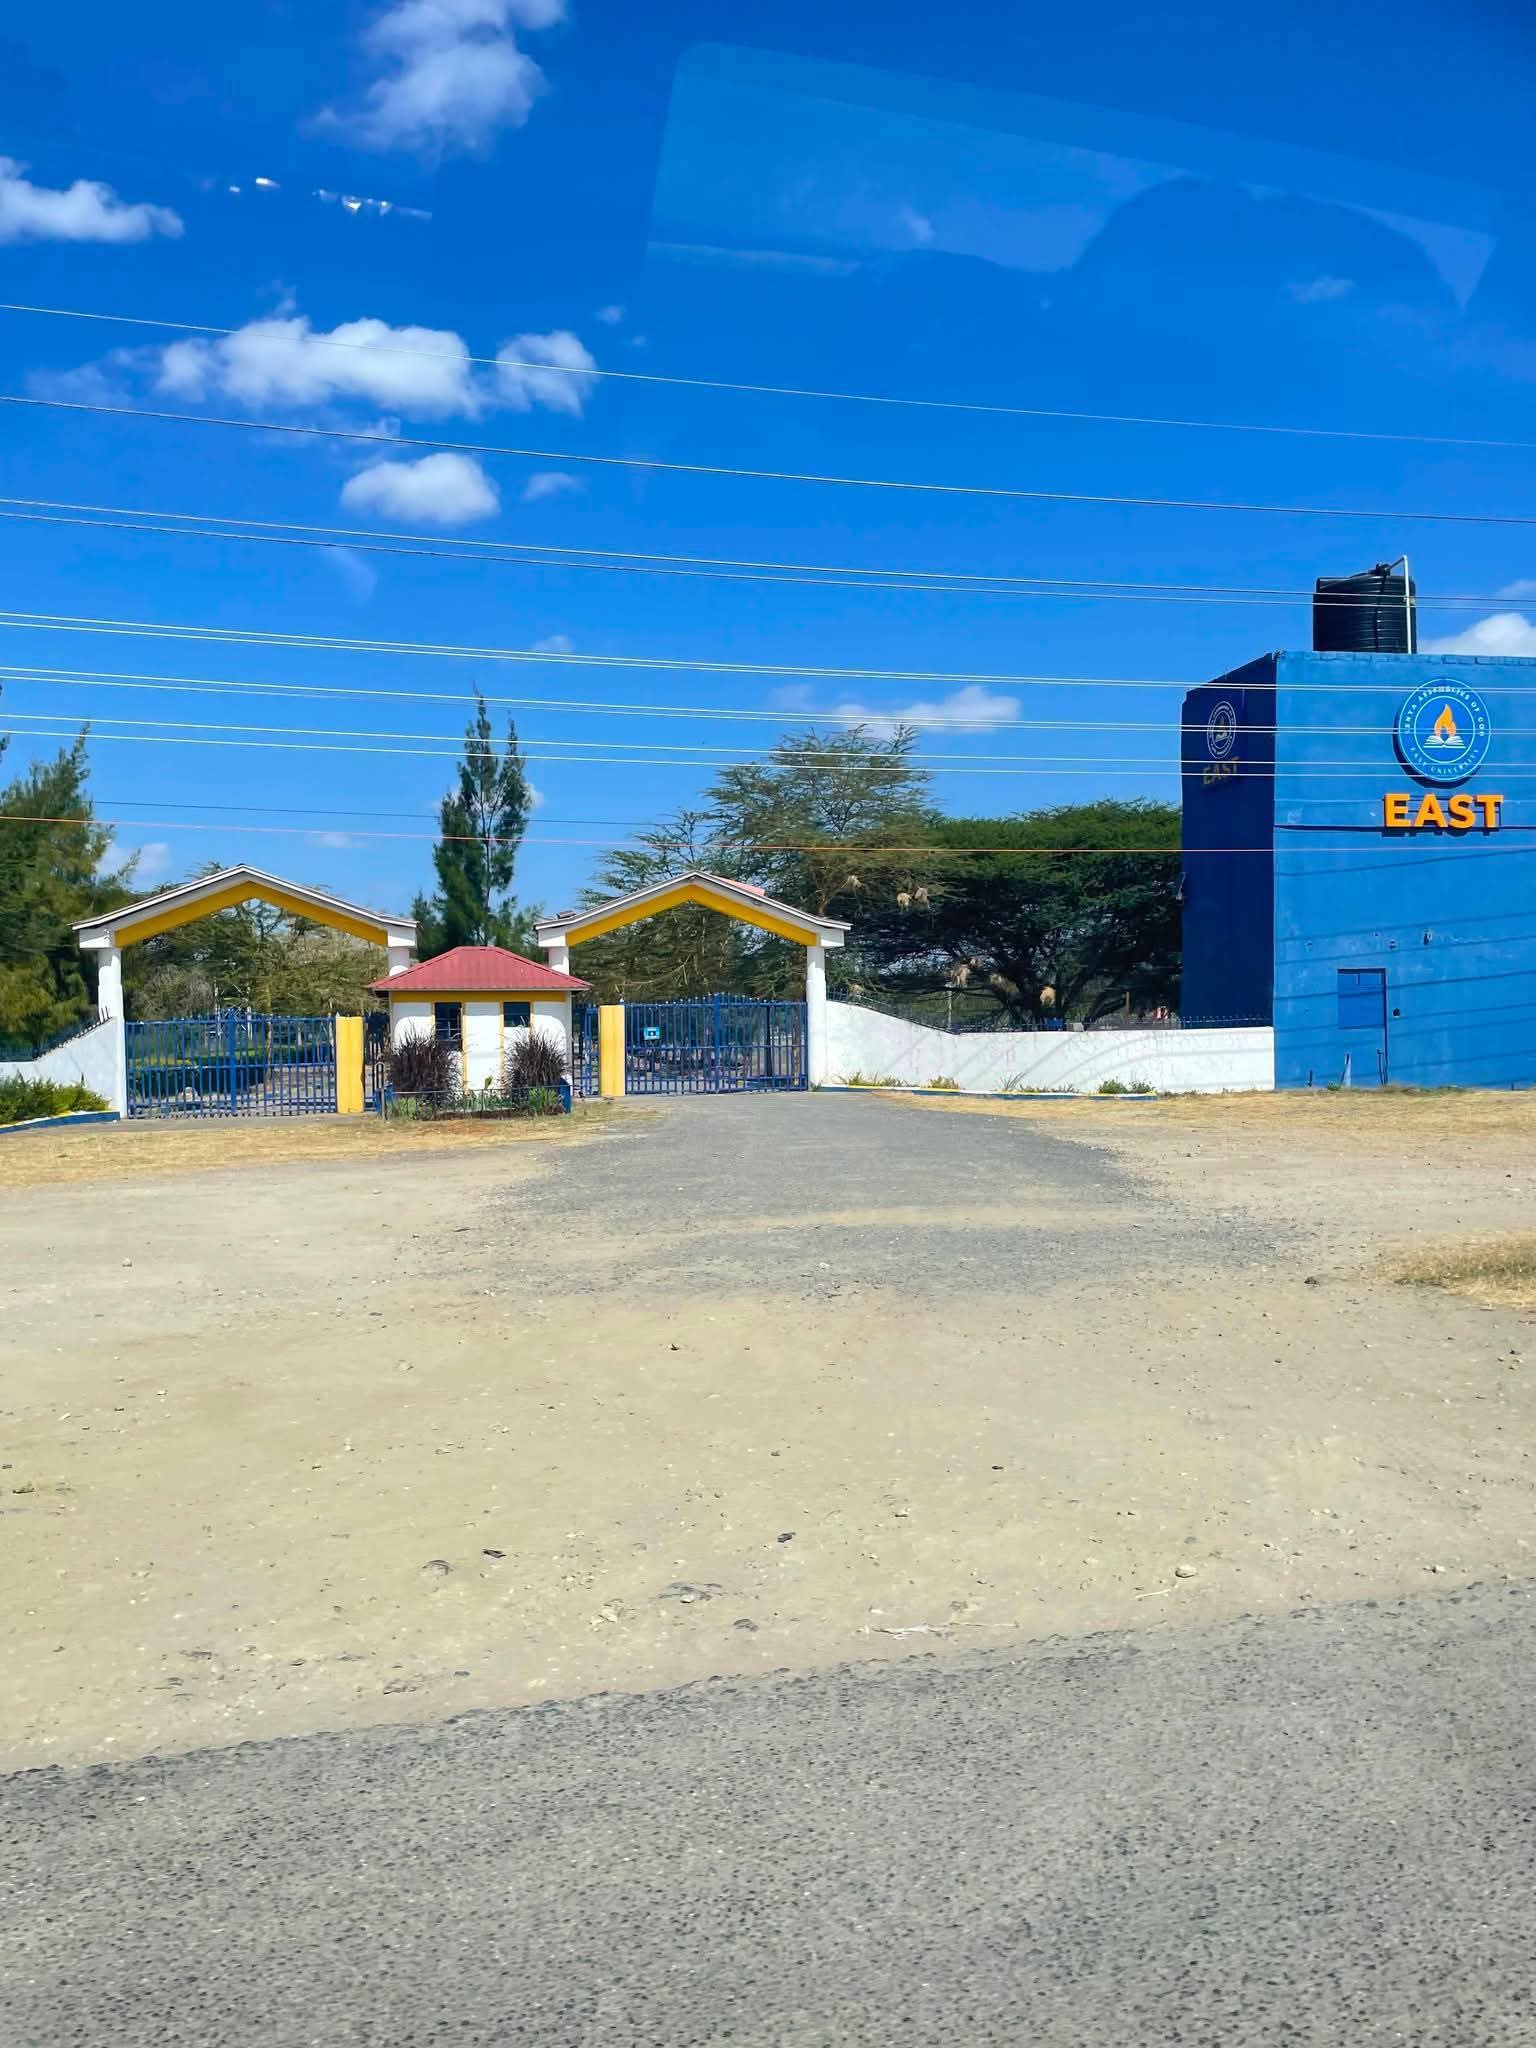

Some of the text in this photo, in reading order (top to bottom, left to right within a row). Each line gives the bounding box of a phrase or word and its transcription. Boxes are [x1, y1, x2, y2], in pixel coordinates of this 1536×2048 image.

[1471, 701, 1480, 712] OF
[1203, 756, 1240, 785] EAST
[1384, 793, 1504, 829] EAST
